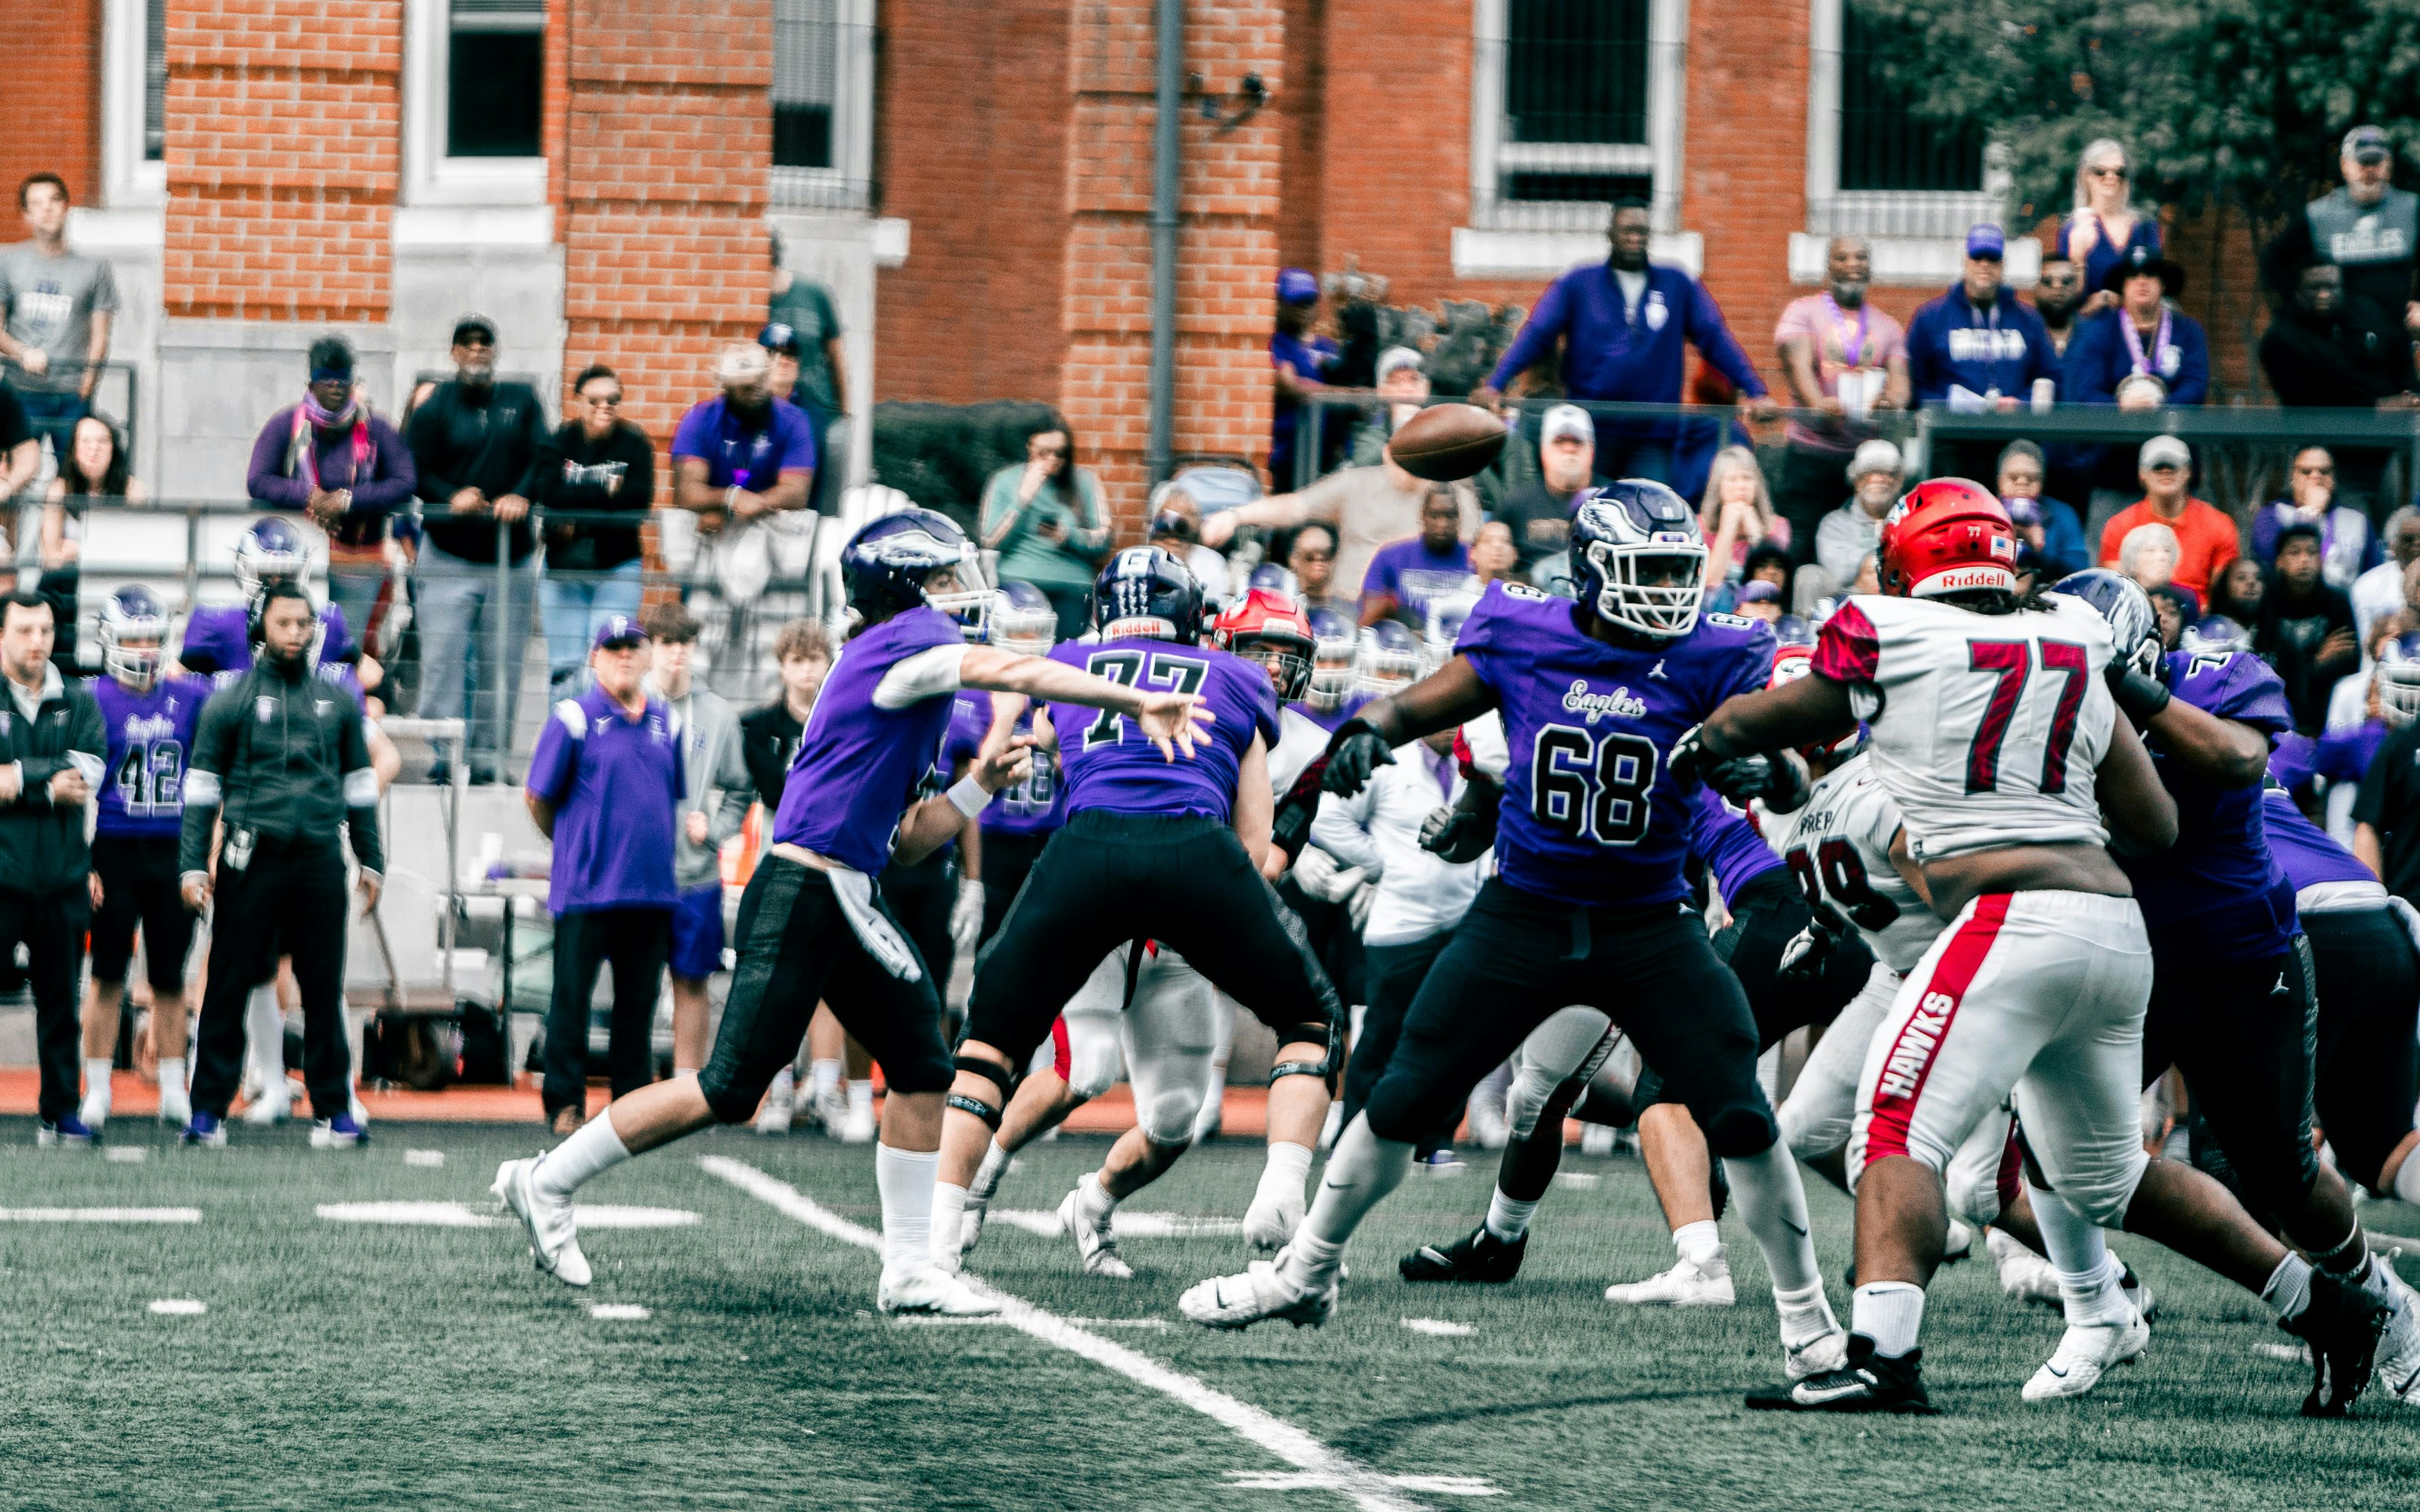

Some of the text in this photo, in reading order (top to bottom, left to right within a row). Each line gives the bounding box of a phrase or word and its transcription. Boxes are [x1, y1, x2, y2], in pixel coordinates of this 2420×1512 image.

[1967, 525, 1981, 538] 77
[1943, 572, 2005, 587] Riddell
[1112, 621, 1161, 636] Riddell
[1562, 679, 1647, 726] Eagles
[1965, 636, 2090, 796] 77
[117, 739, 184, 816] 42
[1531, 722, 1659, 846] 68
[1799, 810, 1833, 835] PREP
[1879, 991, 1954, 1100] HAWKS
